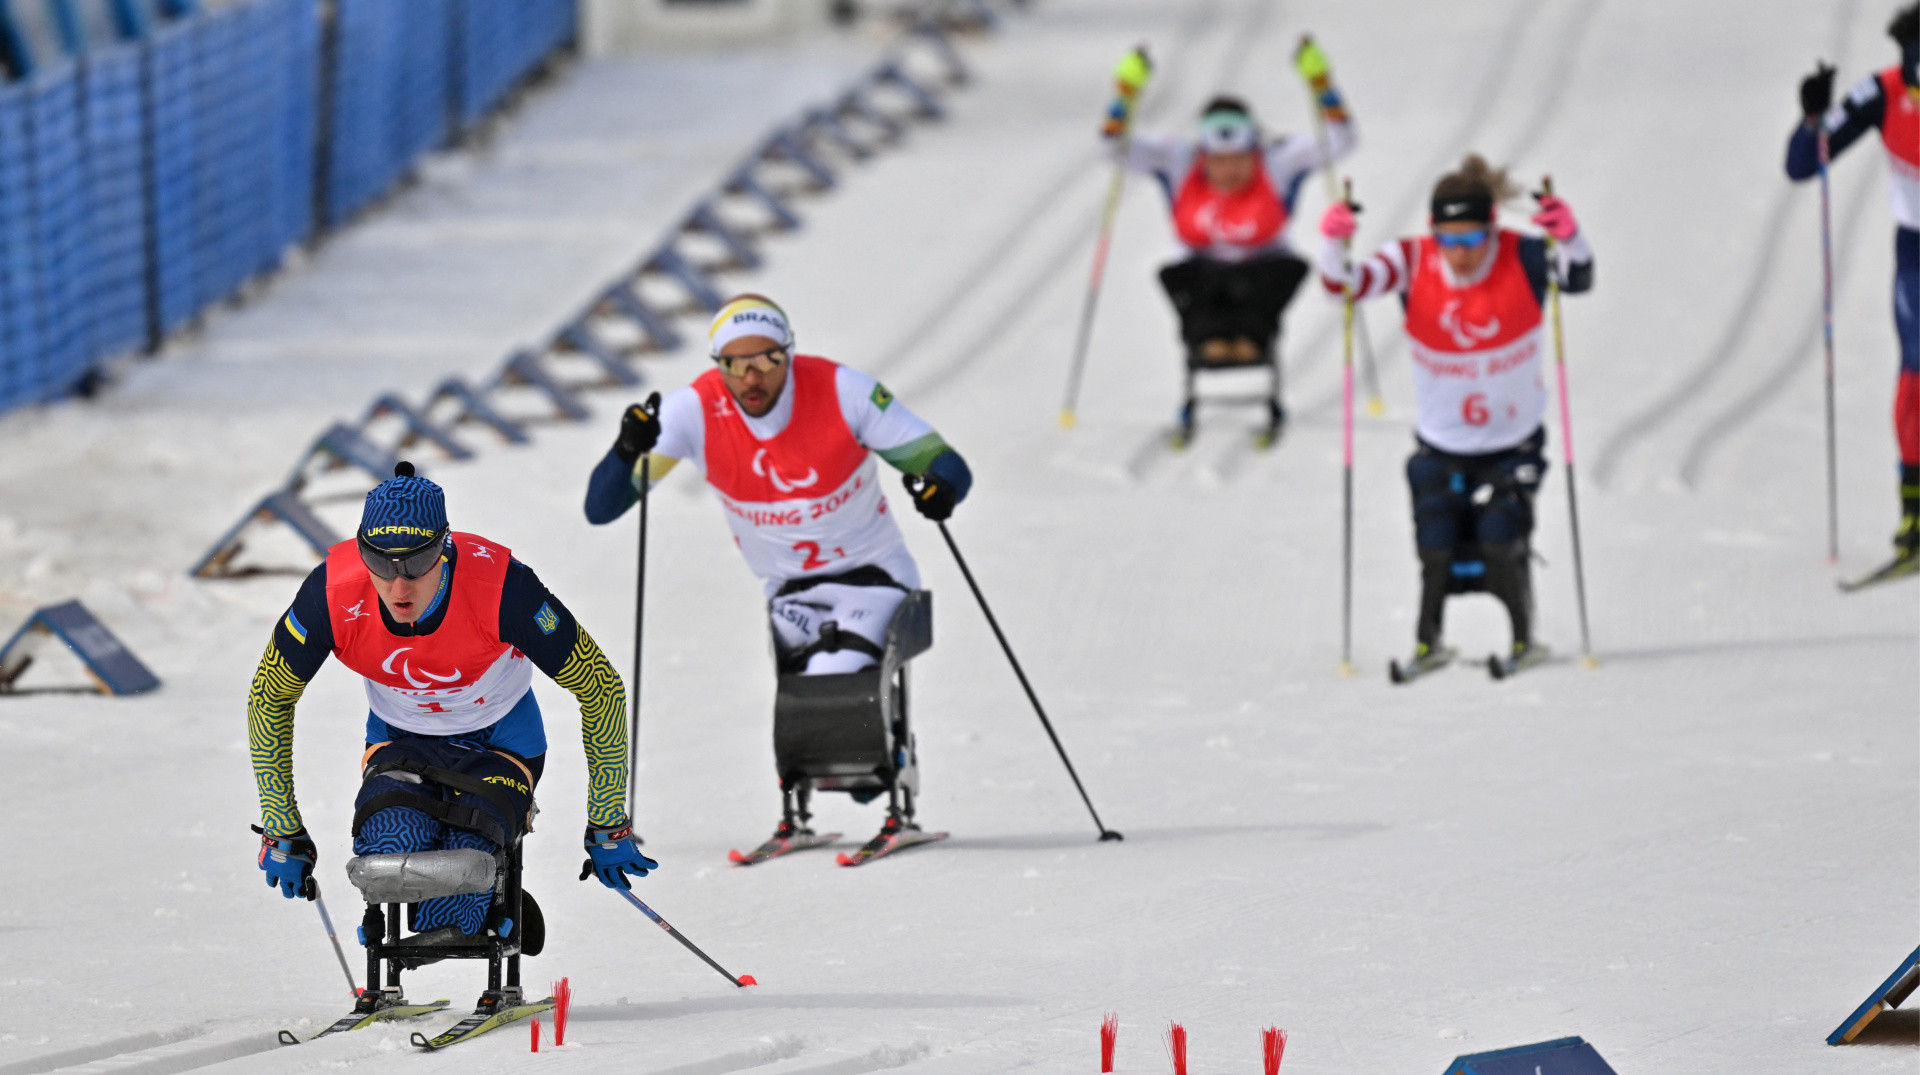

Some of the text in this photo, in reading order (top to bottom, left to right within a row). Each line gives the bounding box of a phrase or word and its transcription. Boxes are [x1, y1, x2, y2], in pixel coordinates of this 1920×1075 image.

[1461, 391, 1491, 428] 6
[367, 525, 434, 538] UKRAINE
[792, 540, 831, 571] 2
